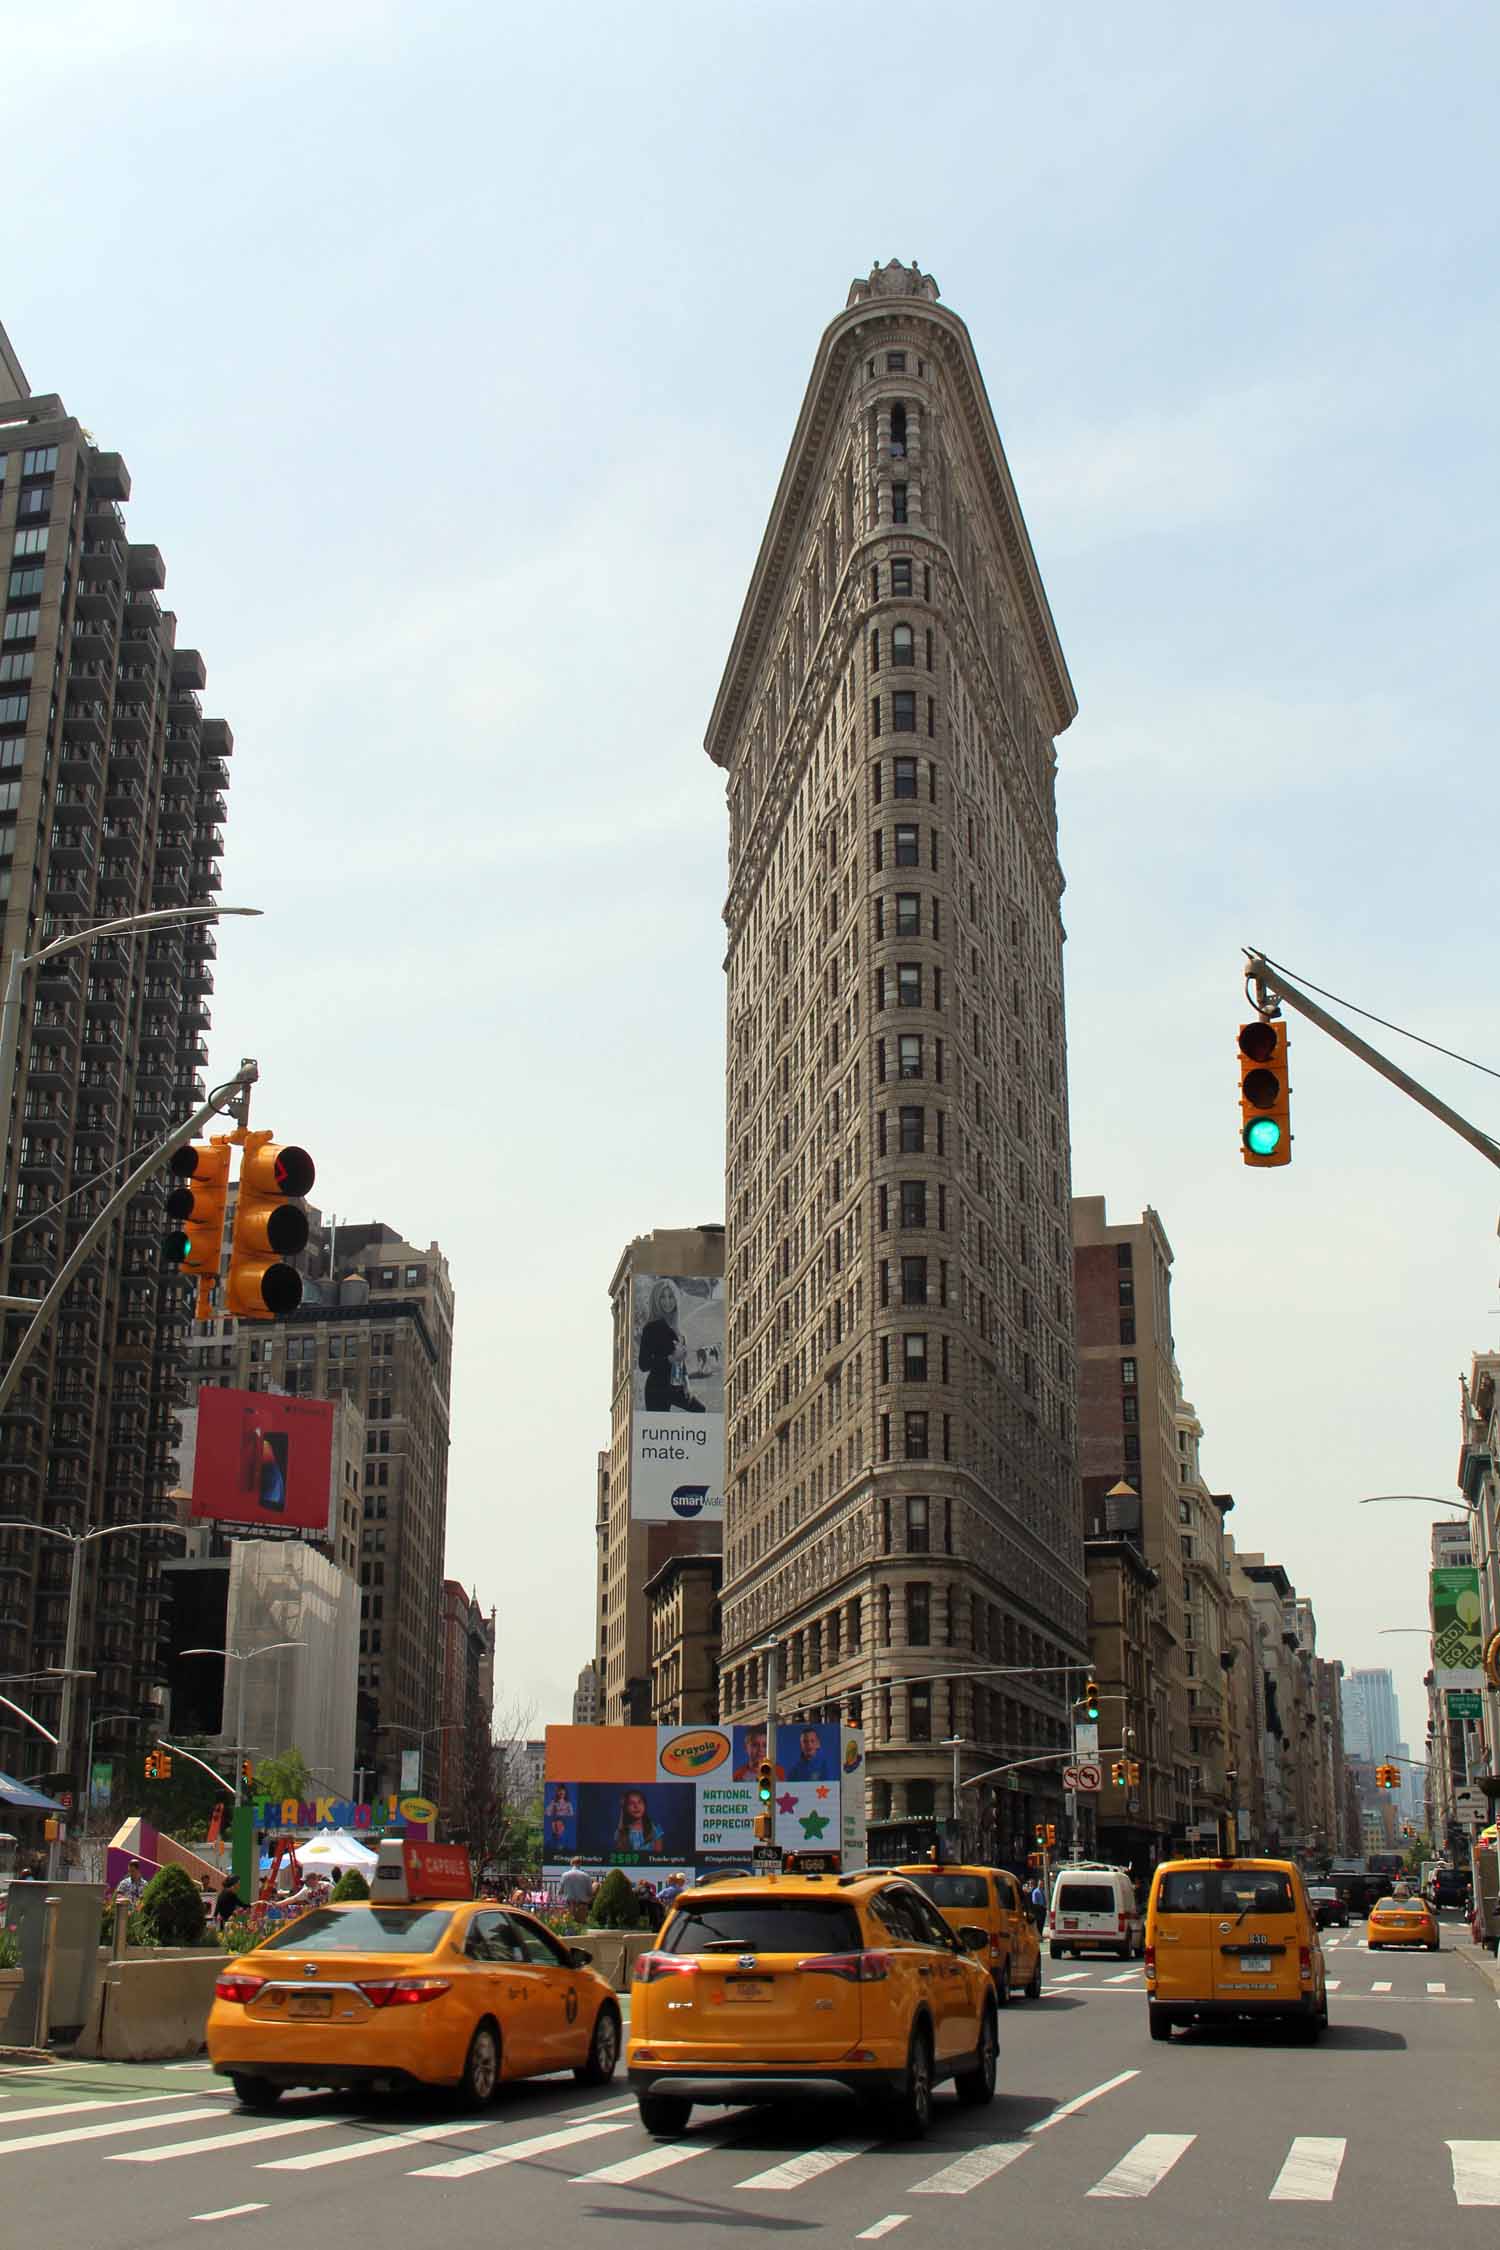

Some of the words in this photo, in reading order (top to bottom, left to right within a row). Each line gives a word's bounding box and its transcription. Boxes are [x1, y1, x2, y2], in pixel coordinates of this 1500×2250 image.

[641, 1426, 706, 1446] running
[641, 1445, 689, 1460] mate.
[672, 1495, 725, 1507] smartwate
[674, 1741, 716, 1759] Crayola
[703, 1789, 753, 1800] NATIONAL
[252, 1795, 335, 1827] THANK
[334, 1793, 398, 1829] YOU!
[703, 1804, 748, 1815] TEACHER
[703, 1818, 754, 1829] APPRECIAT
[703, 1833, 722, 1843] DAY
